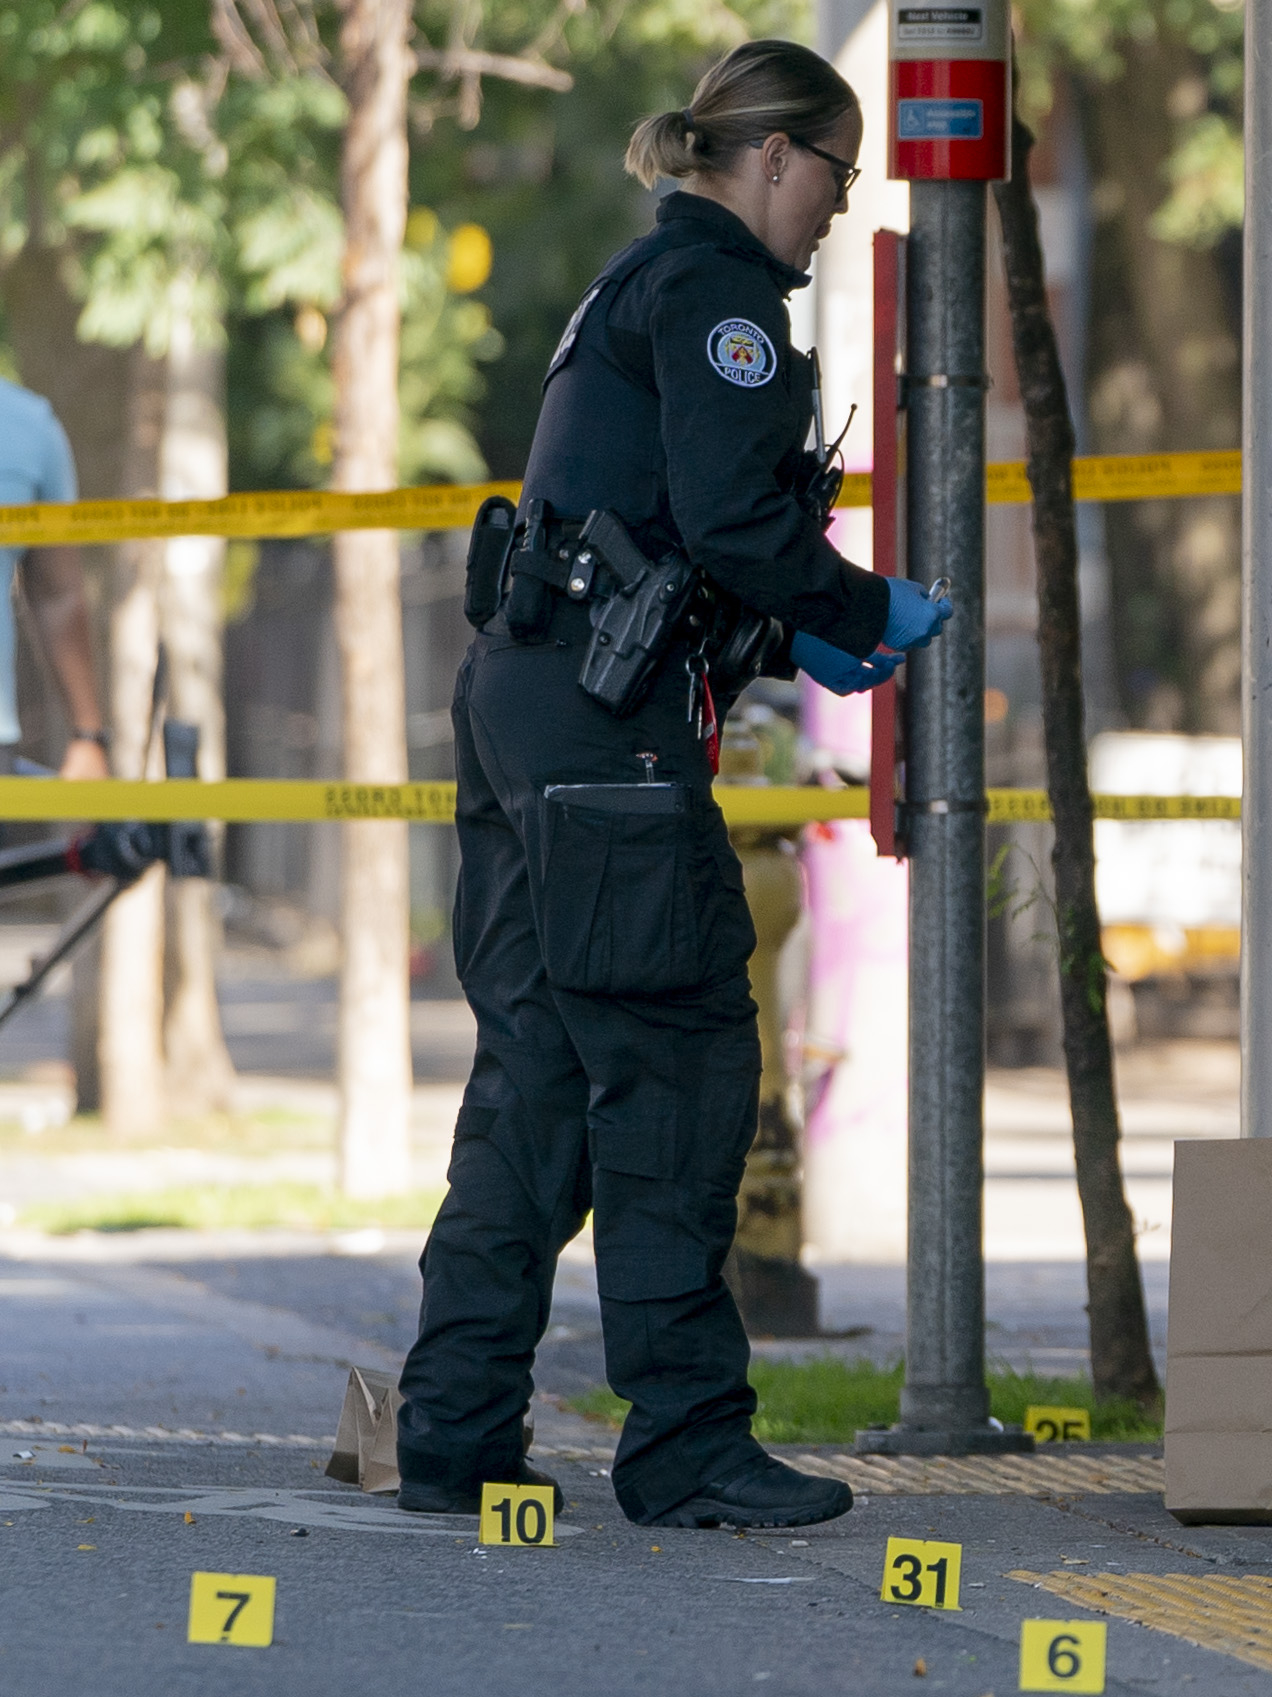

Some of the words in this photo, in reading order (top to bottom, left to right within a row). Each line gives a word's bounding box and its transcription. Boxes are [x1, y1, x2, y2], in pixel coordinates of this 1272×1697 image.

[717, 323, 765, 344] TORONTO
[724, 367, 761, 384] POLICE
[491, 1498, 547, 1544] 10
[890, 1554, 948, 1608] 31
[216, 1591, 251, 1634] 7
[1048, 1634, 1081, 1679] 6
